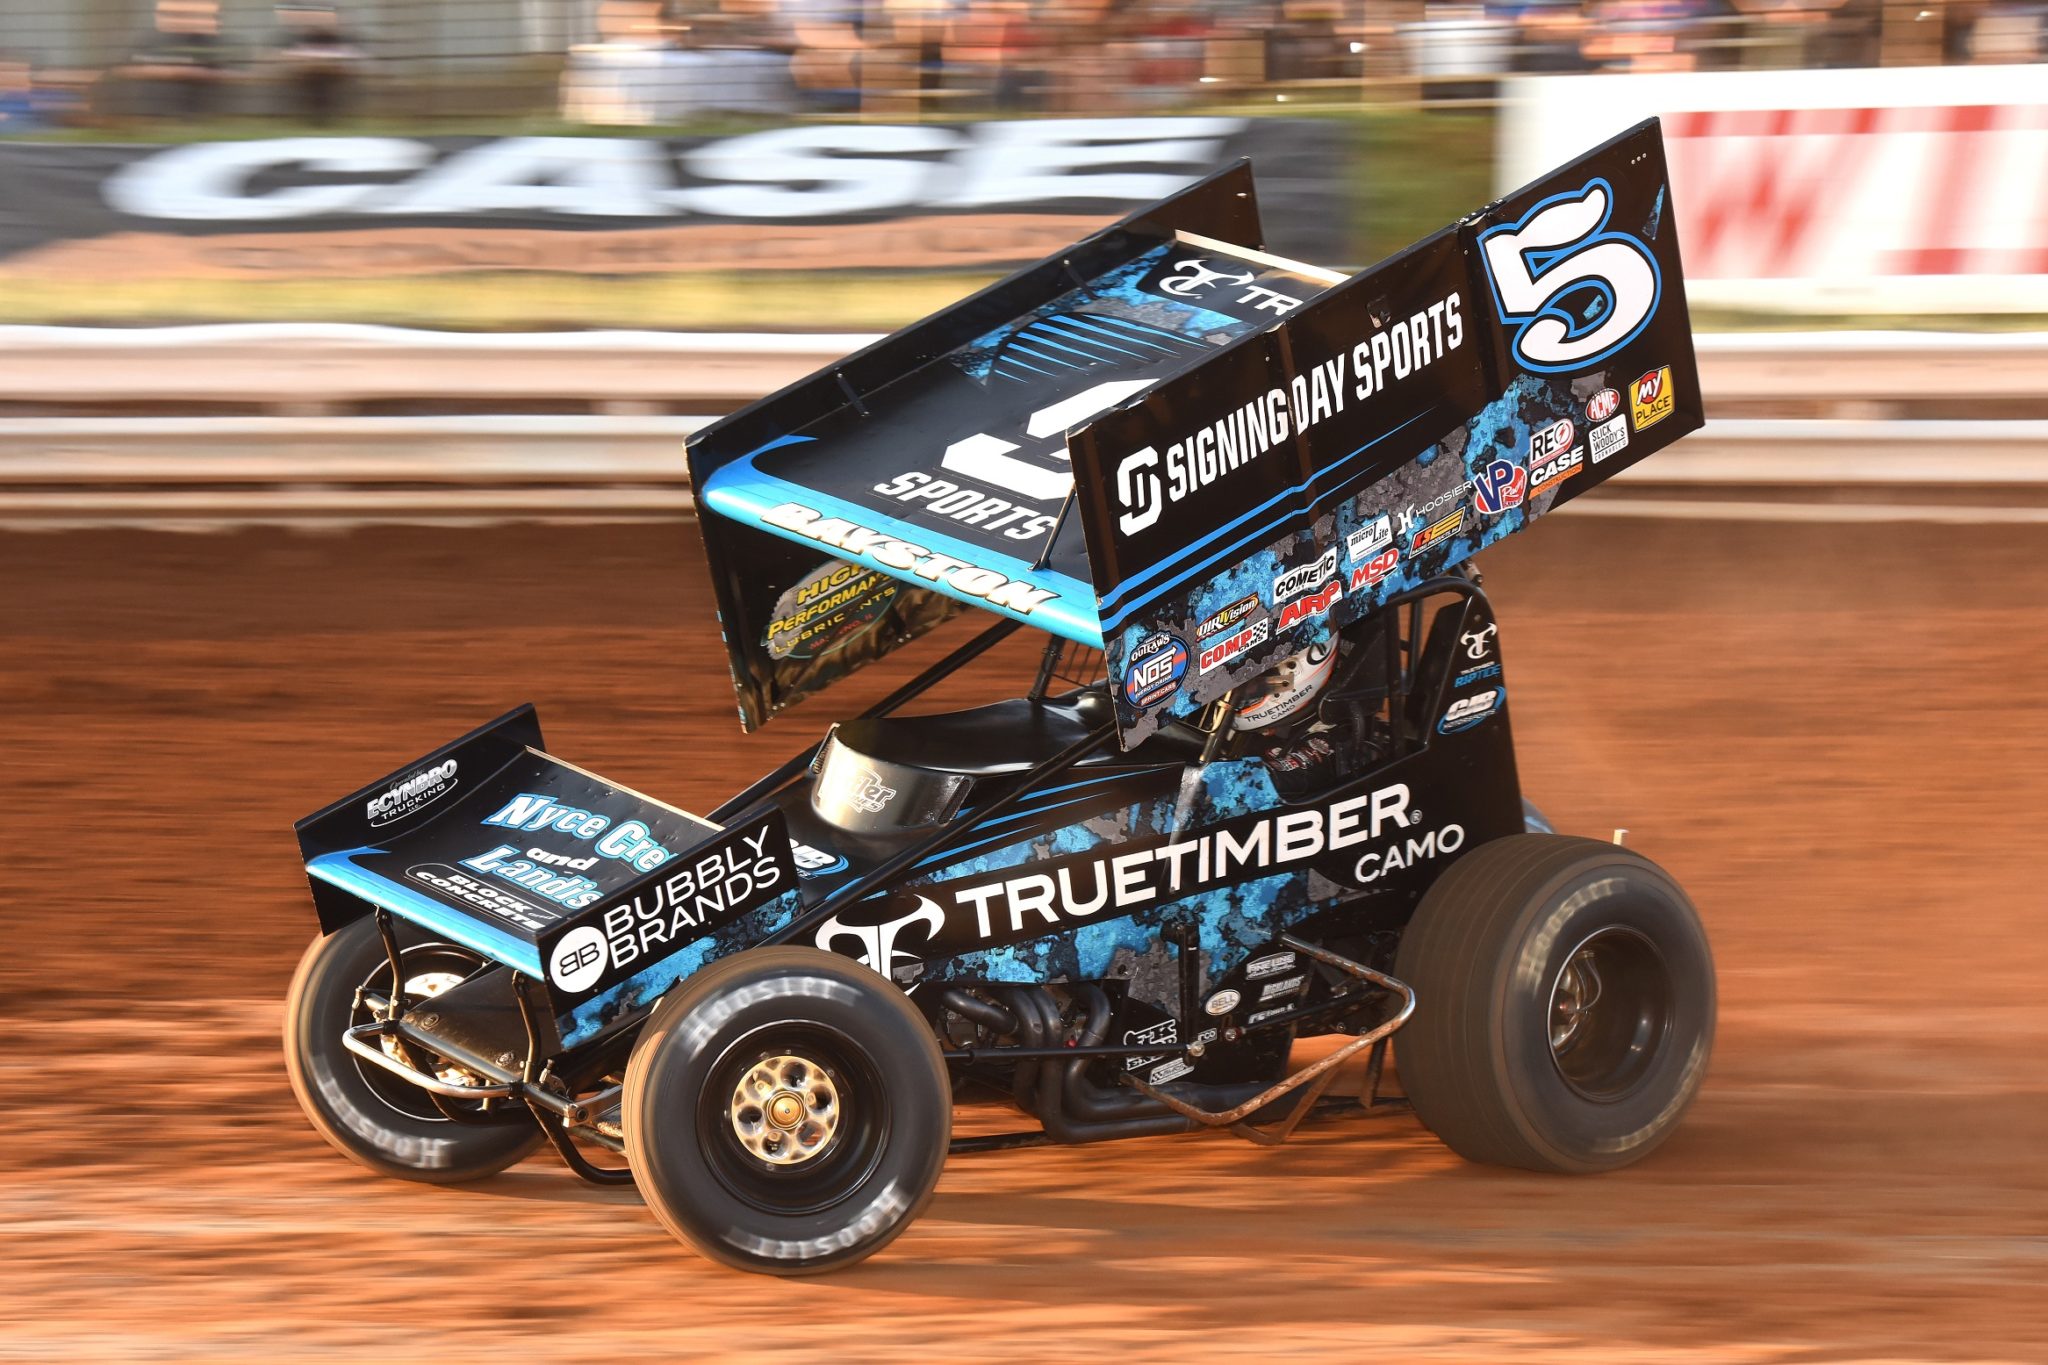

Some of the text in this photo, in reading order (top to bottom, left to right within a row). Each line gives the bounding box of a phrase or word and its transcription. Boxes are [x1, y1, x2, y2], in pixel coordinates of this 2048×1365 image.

[105, 116, 1245, 219] CASE
[1476, 177, 1662, 373] 5
[1167, 388, 1289, 501] SIGNING
[1291, 356, 1347, 437] DAY
[1353, 291, 1464, 409] SPORTS
[1590, 389, 1618, 420] ACME
[1636, 369, 1663, 406] MY
[1636, 395, 1671, 424] PLACE
[1591, 423, 1612, 442] SLICK
[1593, 427, 1626, 452] WOODY'S
[1474, 459, 1515, 513] VP
[1530, 445, 1584, 487] CASE
[1536, 463, 1582, 492] CONSTRUCTION
[872, 471, 1058, 543] SPORTS
[1416, 480, 1472, 517] HOOSIER
[759, 502, 1063, 615] BAYSTON
[1275, 555, 1336, 598] COMETIC
[1350, 548, 1399, 590] MSD
[768, 571, 892, 640] PERFORMAN
[775, 585, 897, 655] LUBRICNTS
[1279, 580, 1341, 630] ARP
[1131, 634, 1171, 662] OUTLAWS
[1201, 629, 1253, 669] COMP
[1238, 634, 1265, 653] CAMS
[1133, 645, 1178, 694] NOS
[1244, 684, 1314, 723] TRUETIMBER
[1271, 704, 1296, 720] CAMO
[366, 758, 458, 820] ECYNBRO
[380, 782, 446, 820] TRUCKING
[482, 793, 677, 873] Nyce Cre
[1354, 823, 1466, 884] CAMO
[459, 844, 605, 910] Landis
[526, 847, 599, 871] and
[956, 783, 1413, 943] TRUETIMBER
[415, 870, 547, 930] CONCRETE
[447, 873, 533, 914] BLOCK
[605, 825, 770, 941] BUBBLY
[608, 856, 782, 969] BRANDS
[1211, 994, 1237, 1009] BELL
